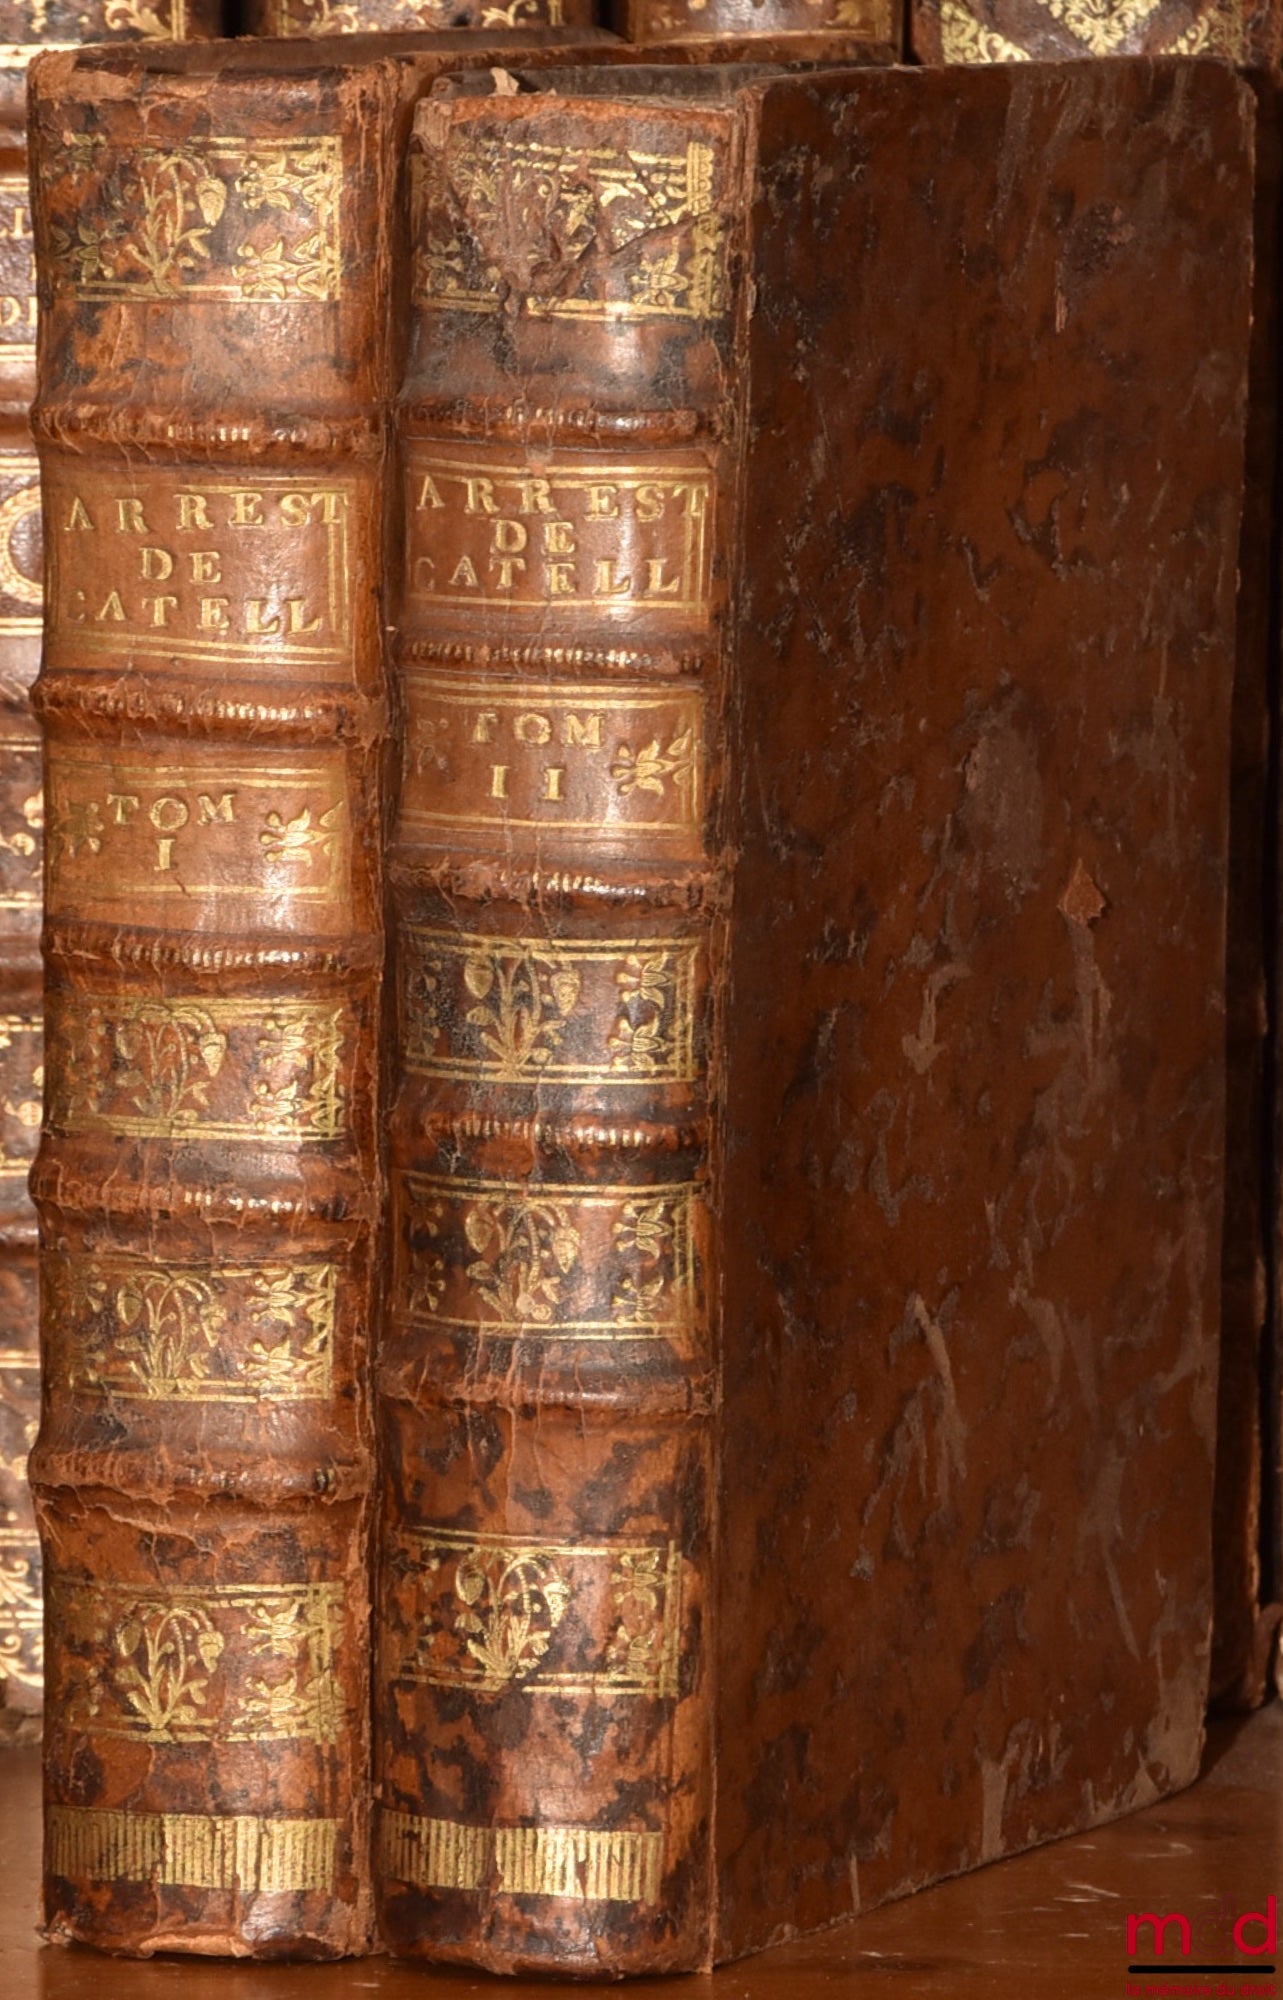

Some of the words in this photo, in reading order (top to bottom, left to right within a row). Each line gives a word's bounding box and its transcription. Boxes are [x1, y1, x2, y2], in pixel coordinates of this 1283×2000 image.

[64, 492, 348, 534] ARREST
[416, 474, 709, 522] ARREST
[490, 519, 576, 554] DE
[139, 547, 222, 584] DE
[107, 794, 236, 831] TOM
[153, 838, 178, 871] I
